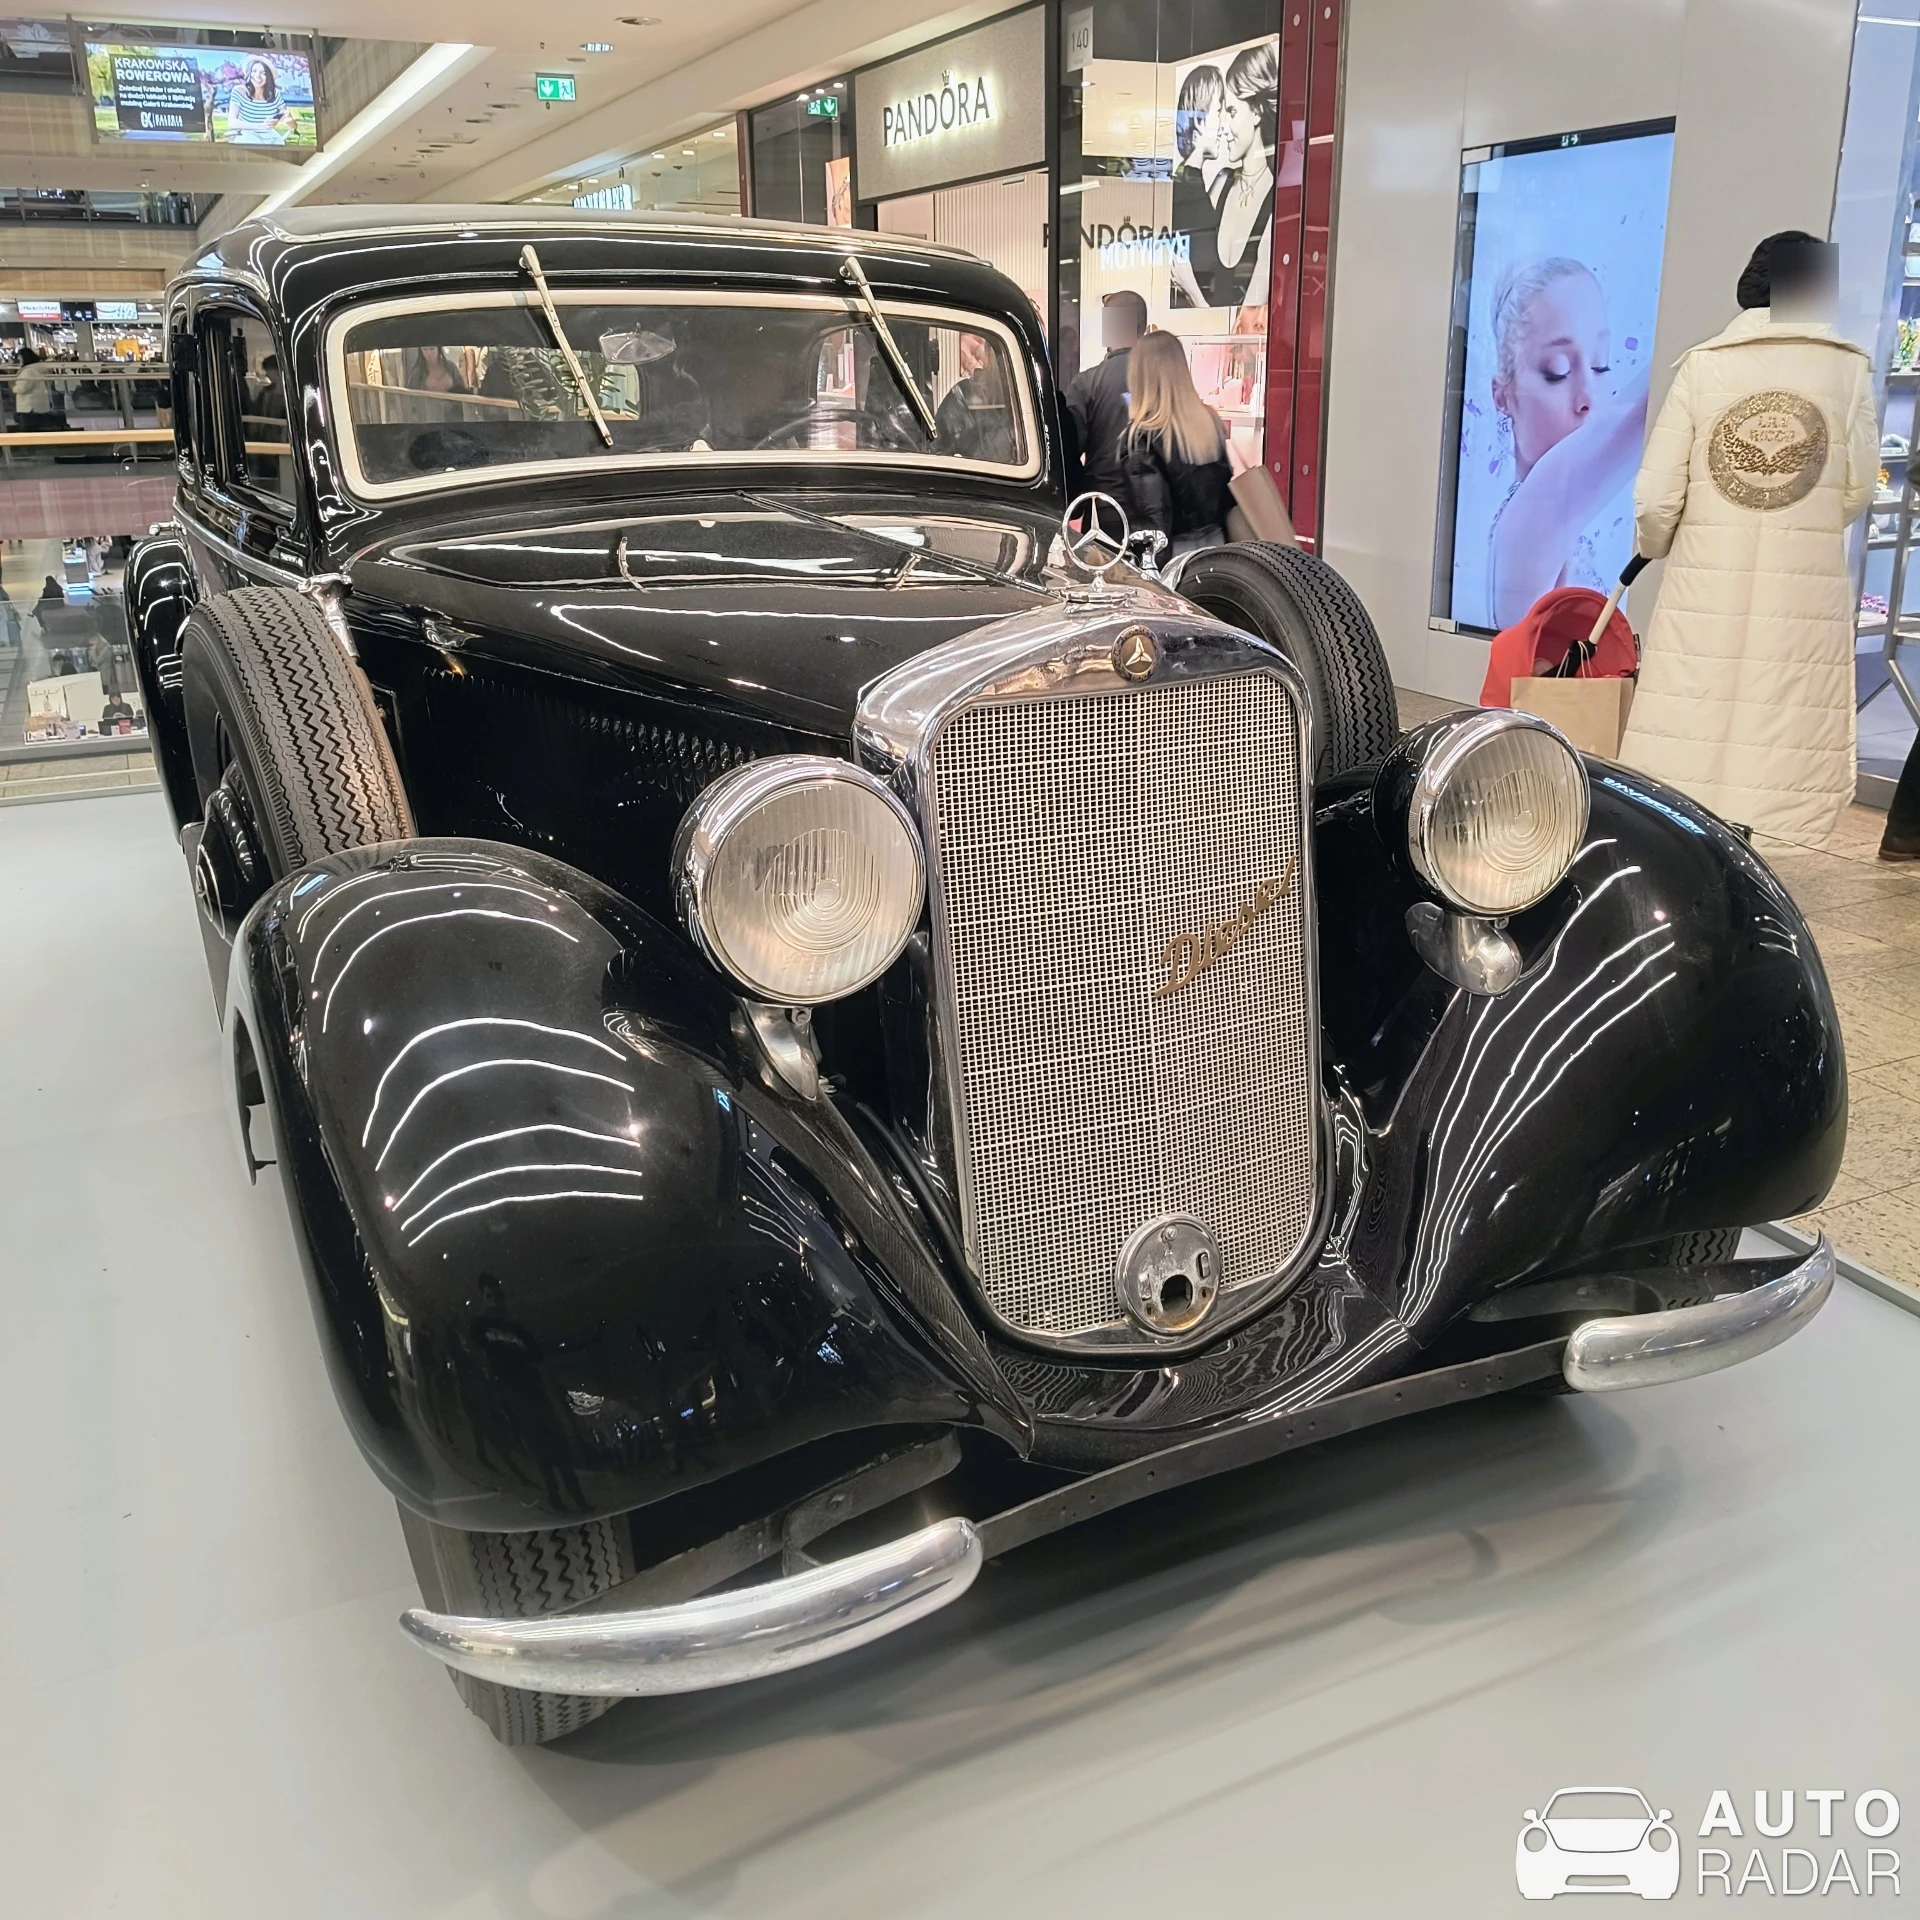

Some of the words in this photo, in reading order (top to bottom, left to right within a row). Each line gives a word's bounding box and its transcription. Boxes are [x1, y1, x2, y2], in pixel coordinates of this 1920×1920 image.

[1072, 28, 1088, 52] 140
[115, 57, 188, 71] KRAKOWSKA
[116, 69, 195, 83] ROWEROWA!
[883, 77, 990, 147] PANDORA
[1155, 856, 1296, 998] Diesel
